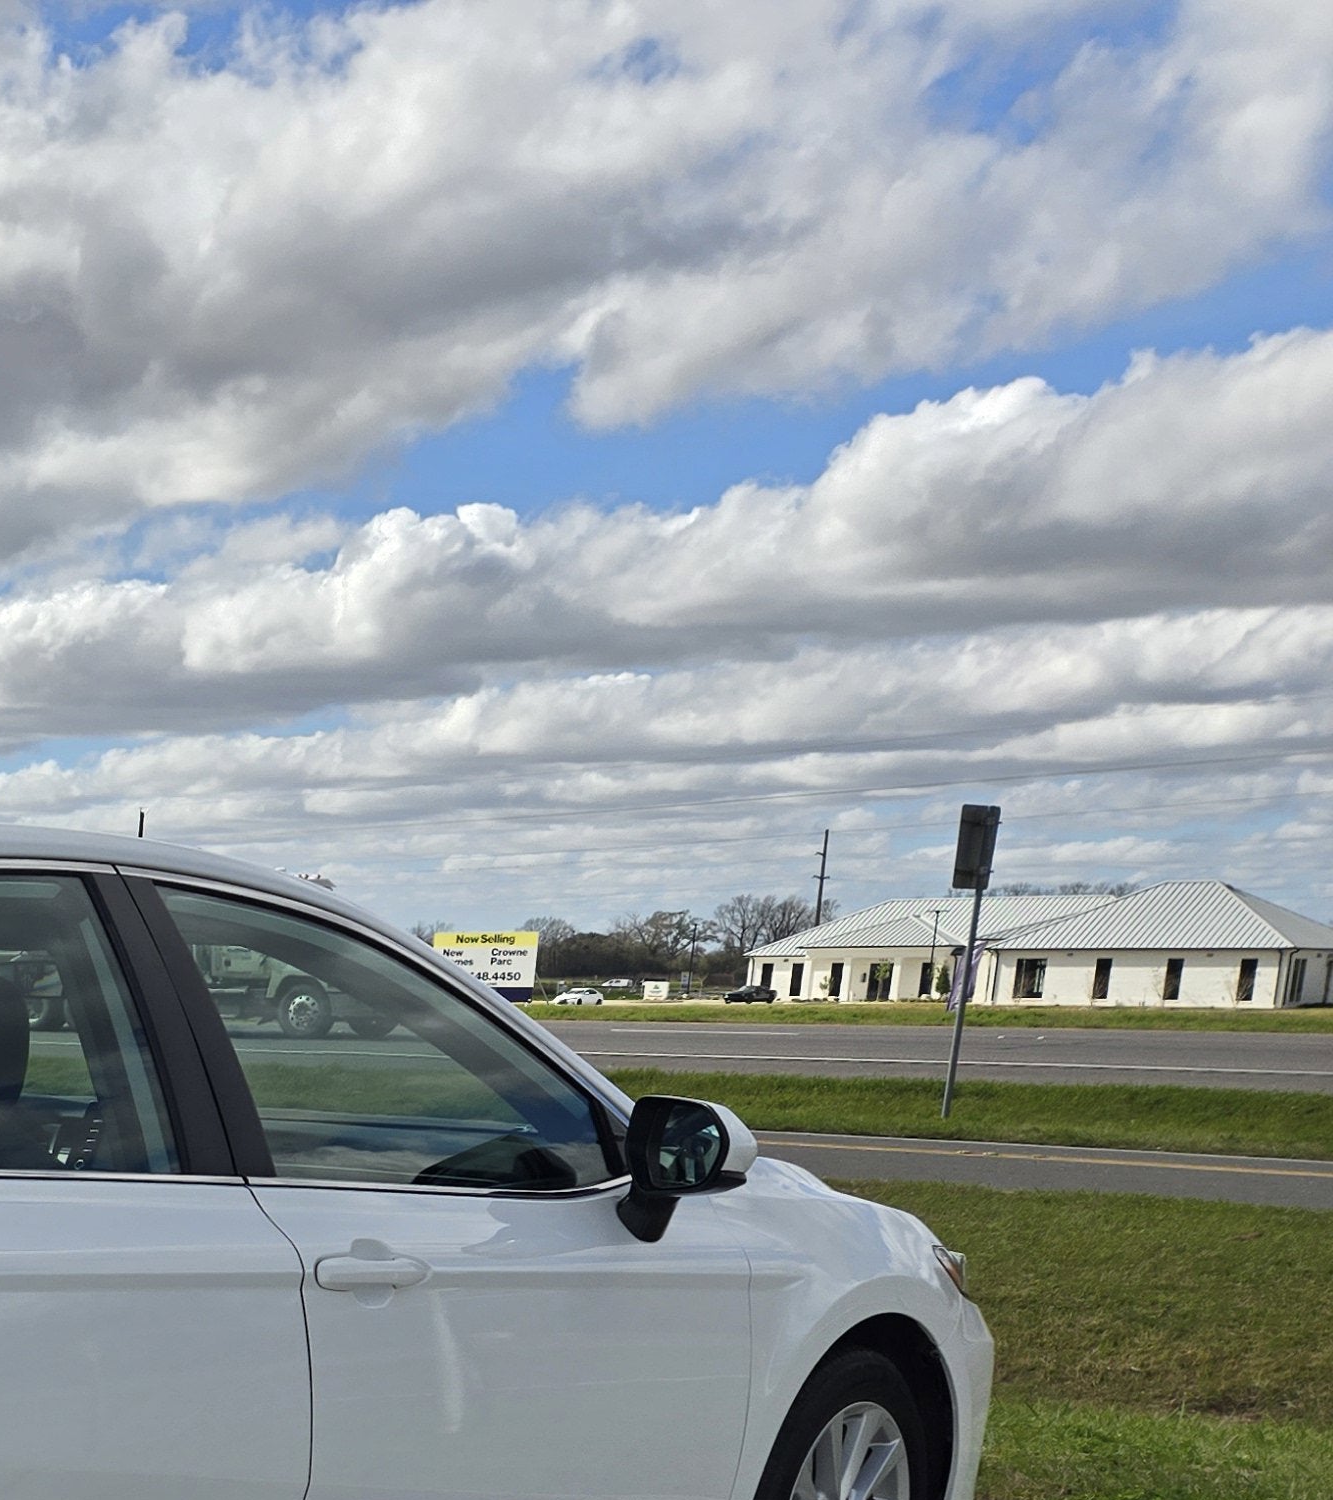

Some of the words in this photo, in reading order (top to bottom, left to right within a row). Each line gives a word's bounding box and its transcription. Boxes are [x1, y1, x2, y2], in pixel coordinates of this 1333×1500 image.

[455, 934, 479, 944] Now
[480, 933, 516, 945] Selling
[442, 948, 464, 957] New
[491, 948, 529, 957] Crowne
[490, 957, 513, 966] Parc
[470, 971, 521, 981] 48.4450
